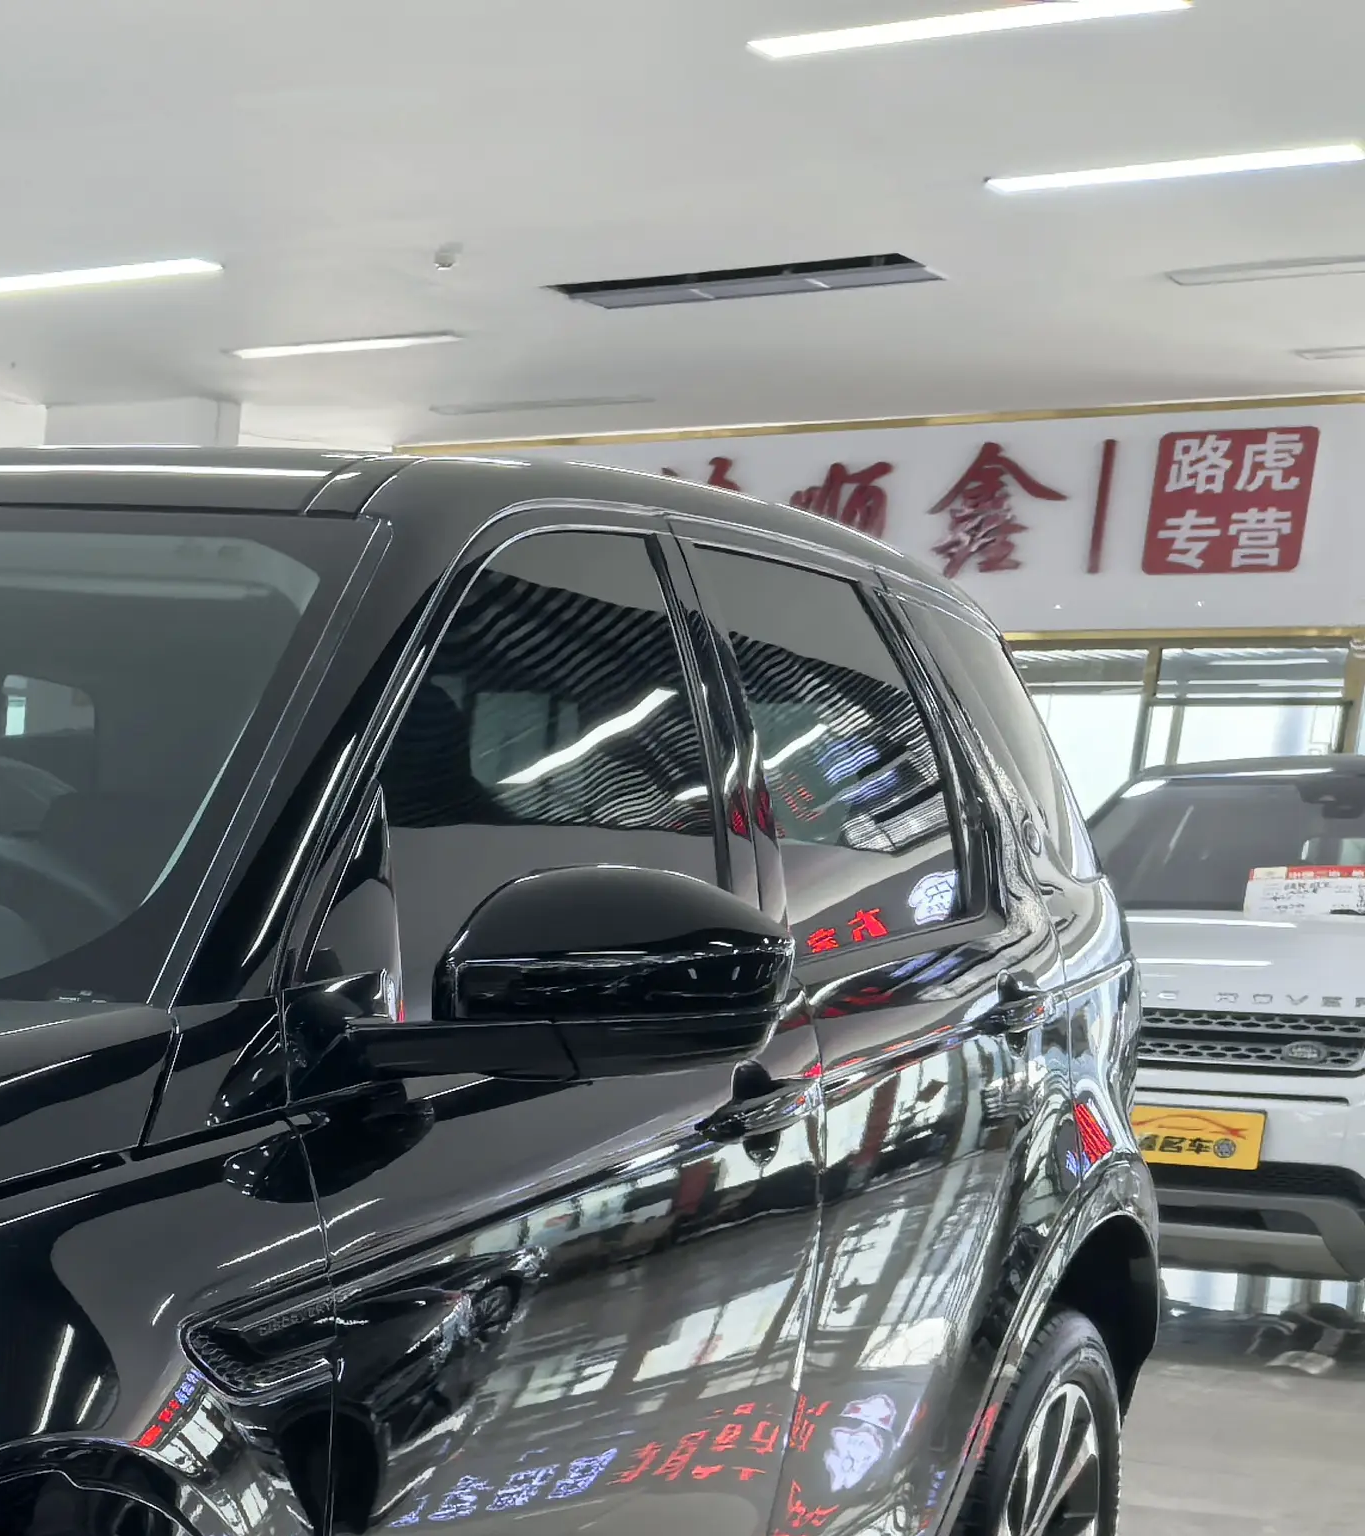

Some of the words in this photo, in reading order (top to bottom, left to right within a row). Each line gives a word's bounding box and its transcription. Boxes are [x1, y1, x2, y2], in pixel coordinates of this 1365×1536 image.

[1164, 431, 1304, 494] 路虎
[662, 441, 1068, 579] 顺鑫
[1157, 507, 1293, 569] 专营
